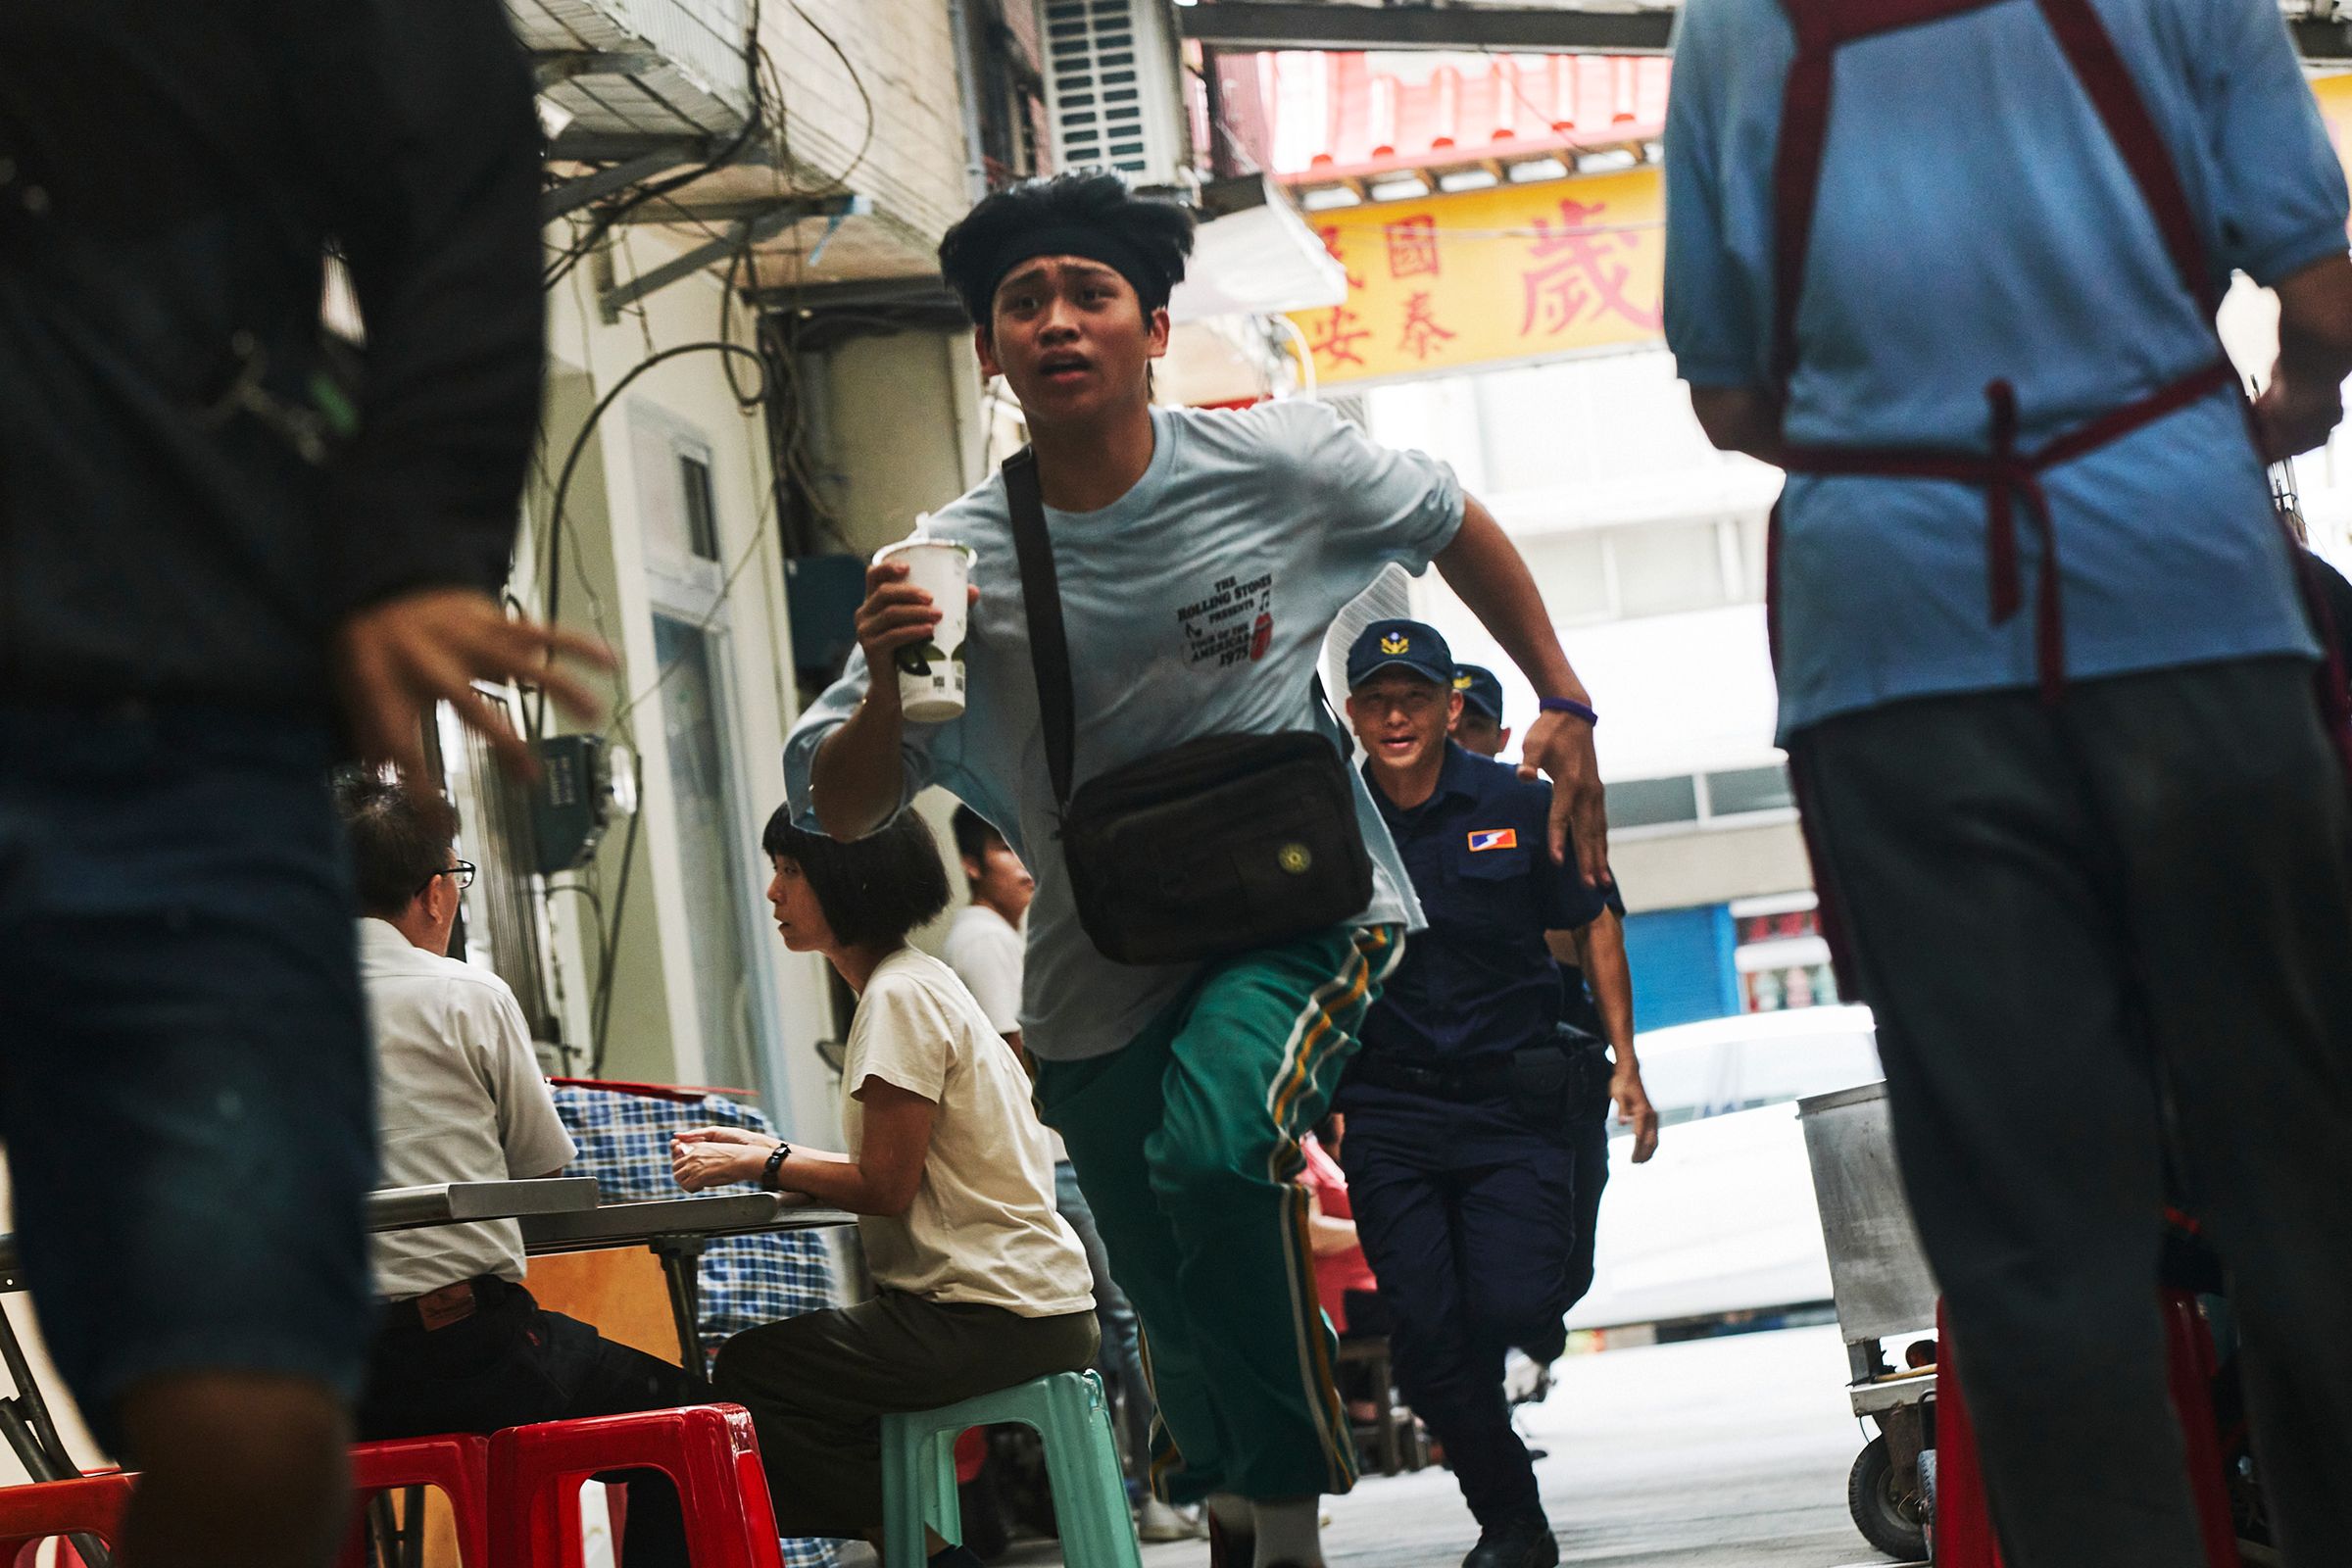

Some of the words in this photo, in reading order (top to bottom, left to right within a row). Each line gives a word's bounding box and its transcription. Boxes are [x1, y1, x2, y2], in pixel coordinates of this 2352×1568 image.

[1177, 591, 1232, 622] ROLLING
[1235, 573, 1272, 600] STONES
[1214, 575, 1237, 593] THE
